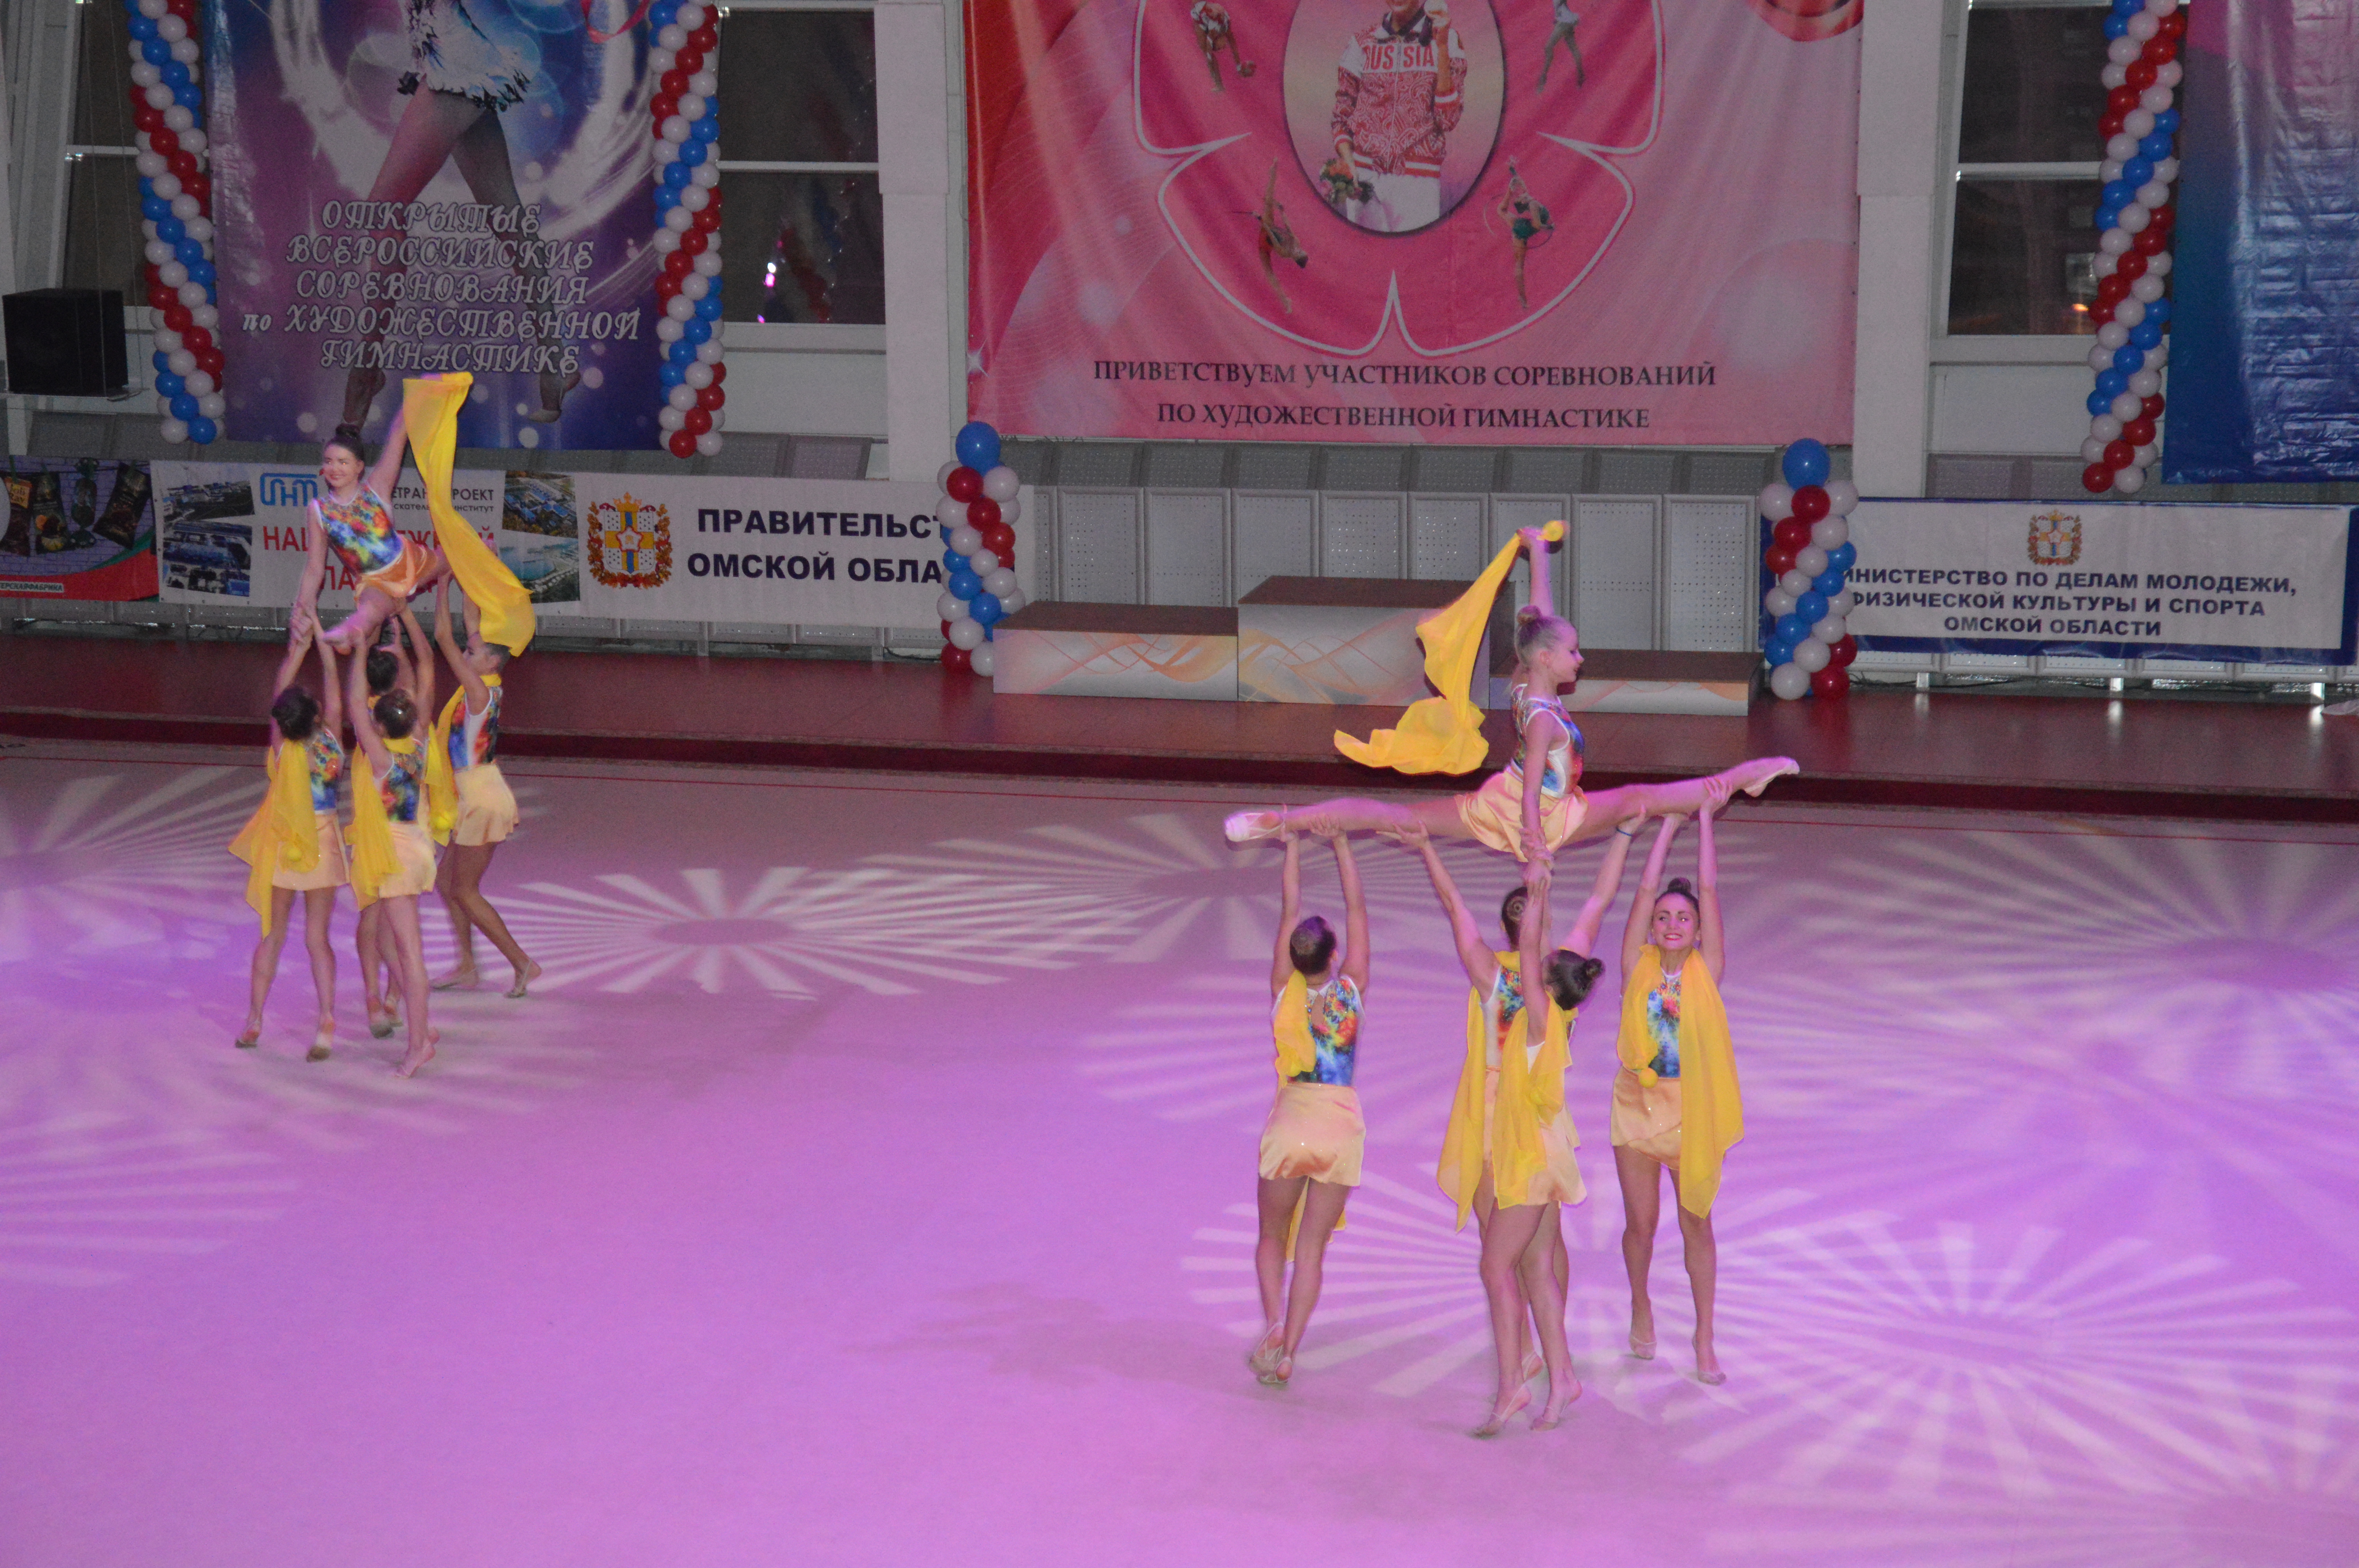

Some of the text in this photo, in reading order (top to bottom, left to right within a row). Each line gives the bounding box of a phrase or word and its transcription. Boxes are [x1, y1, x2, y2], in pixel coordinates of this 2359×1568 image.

[322, 200, 541, 237] ОТКРЫТЫЕ
[286, 234, 594, 273] ВСЕРОССИЙСКИЕ
[296, 270, 589, 304] СОРЕВНОВАНИЯ
[284, 304, 641, 343] ХУДОЖЕСТВЕННОЙ
[320, 339, 580, 377] ГИМНАСТИКЕ
[1094, 361, 1717, 388] ПРИВЕТСТВУЕМ УЧАСТНИКОВ СОРЕВНОВАНИЙ
[1157, 403, 1650, 428] ПО ХУДОЖЕСТВЕННОЙ ГИМНАСТИКЕ
[698, 508, 942, 539] ПРАВИТЕЛЬС
[687, 551, 941, 584] ОМСКОЙ ОБЛА
[1844, 568, 2297, 596] ИНИСТЕРСТВО ПО ДЕЛАМ МОЛОДЕЖИ,
[2013, 595, 2136, 613] КУЛЬТУРЫ
[2145, 597, 2161, 613] И
[2169, 598, 2265, 616] СПОРТА
[1945, 615, 2161, 636] ОМСКОЙ ОБЛАСТИ
